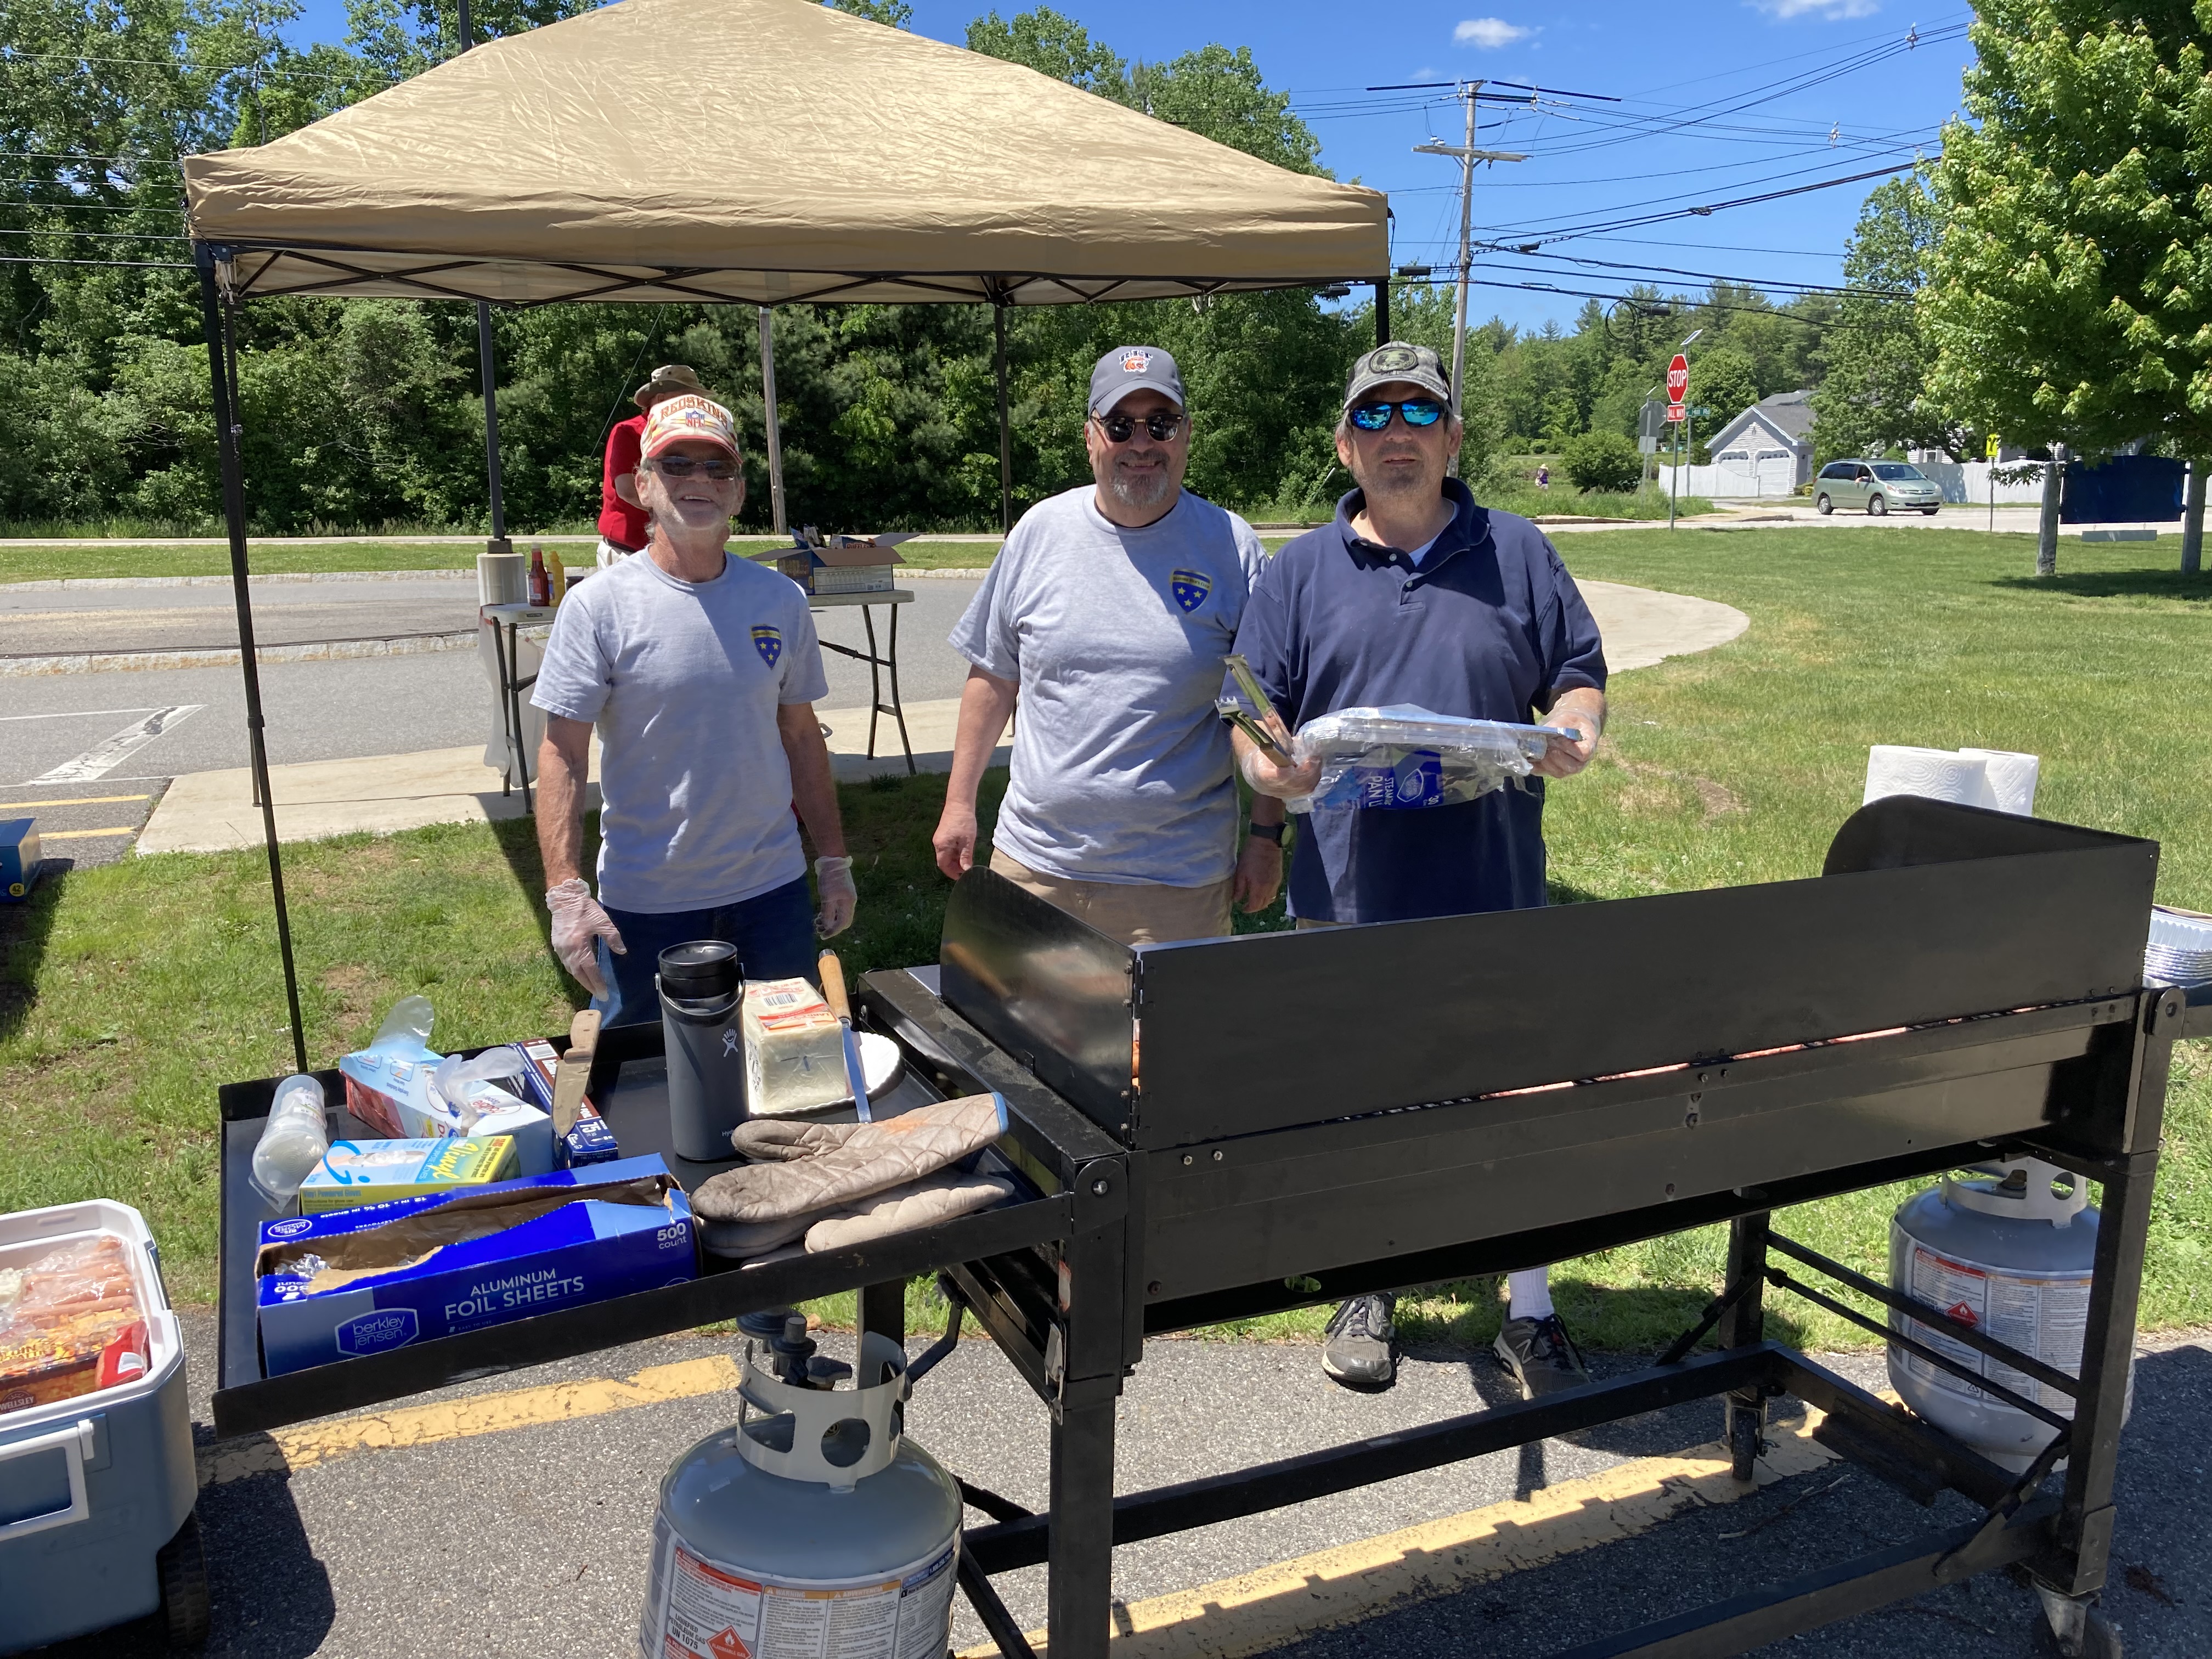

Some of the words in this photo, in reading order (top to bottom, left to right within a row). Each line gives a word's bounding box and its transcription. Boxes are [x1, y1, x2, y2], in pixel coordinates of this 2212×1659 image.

[1668, 370, 1687, 387] STOP
[660, 396, 728, 431] REDSKINS
[1676, 408, 1684, 417] WAY
[686, 418, 705, 428] NFL
[1368, 776, 1383, 798] PAN
[579, 1122, 601, 1133] 75
[428, 1143, 479, 1179] Vinyl
[320, 1210, 349, 1218] Sheets
[274, 1223, 306, 1233] MORE
[657, 1222, 686, 1241] 500
[658, 1235, 687, 1249] count
[470, 1268, 556, 1297] ALUMINUM
[444, 1296, 496, 1321] FOIL
[503, 1276, 585, 1307] SHEETS
[353, 1316, 405, 1335] berkley
[354, 1328, 403, 1350] jensen
[0, 1396, 35, 1410] WELLSLEY
[776, 1589, 805, 1599] WARNING
[843, 1586, 883, 1598] ADVERTENCIA
[675, 1613, 698, 1633] LIQUEFIED
[672, 1626, 680, 1639] UN
[681, 1634, 699, 1650] 1075
[695, 1634, 706, 1645] GAS
[672, 1639, 690, 1657] PELIGRO
[712, 1643, 736, 1655] FLAMMABLE
